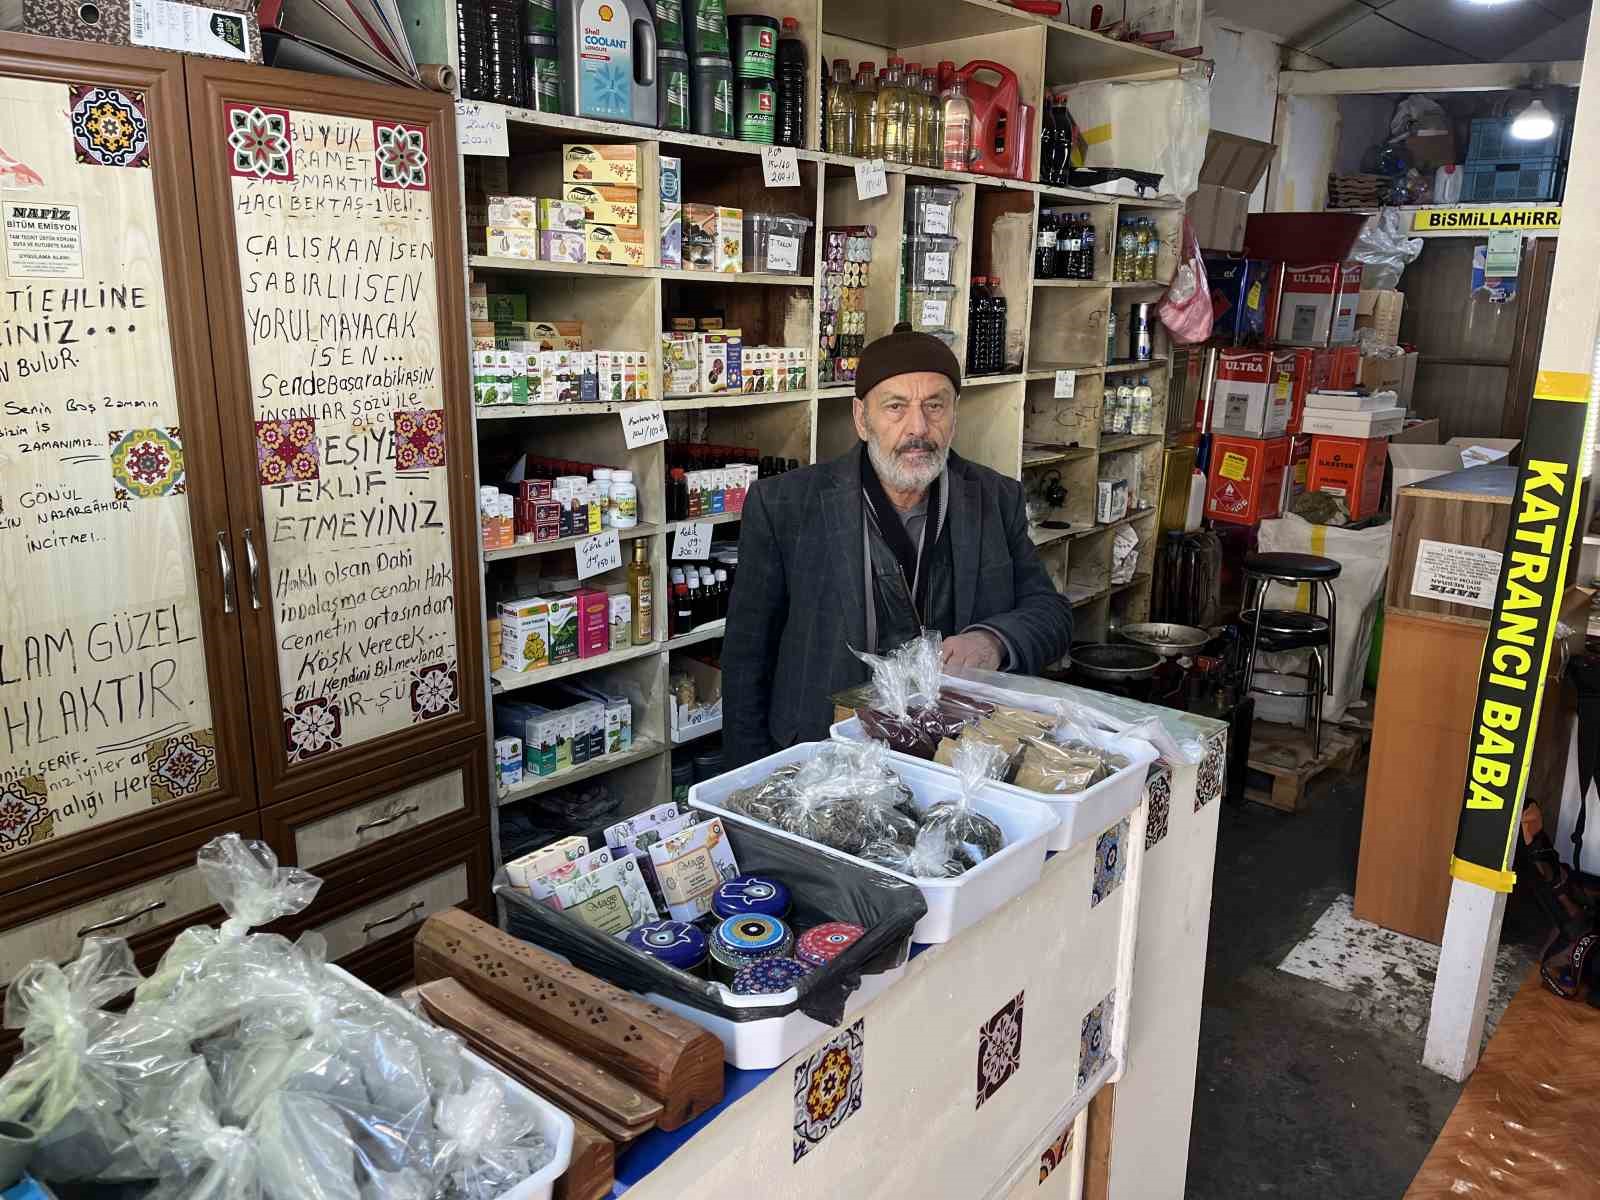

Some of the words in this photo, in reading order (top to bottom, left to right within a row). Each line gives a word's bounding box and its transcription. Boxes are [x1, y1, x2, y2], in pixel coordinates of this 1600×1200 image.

[585, 36, 627, 48] COOLANT
[293, 149, 372, 171] RAMET
[1293, 274, 1331, 284] ULTRA
[248, 307, 417, 345] YORULMAYACAK
[1226, 361, 1263, 373] ULTRA
[318, 426, 397, 466] ESİYE
[20, 482, 82, 508] GÖNÜL
[271, 467, 386, 508] TEKLİF
[1487, 458, 1569, 692] KATRANCI
[87, 602, 197, 664] GÜZEL
[1465, 698, 1522, 811] BABA
